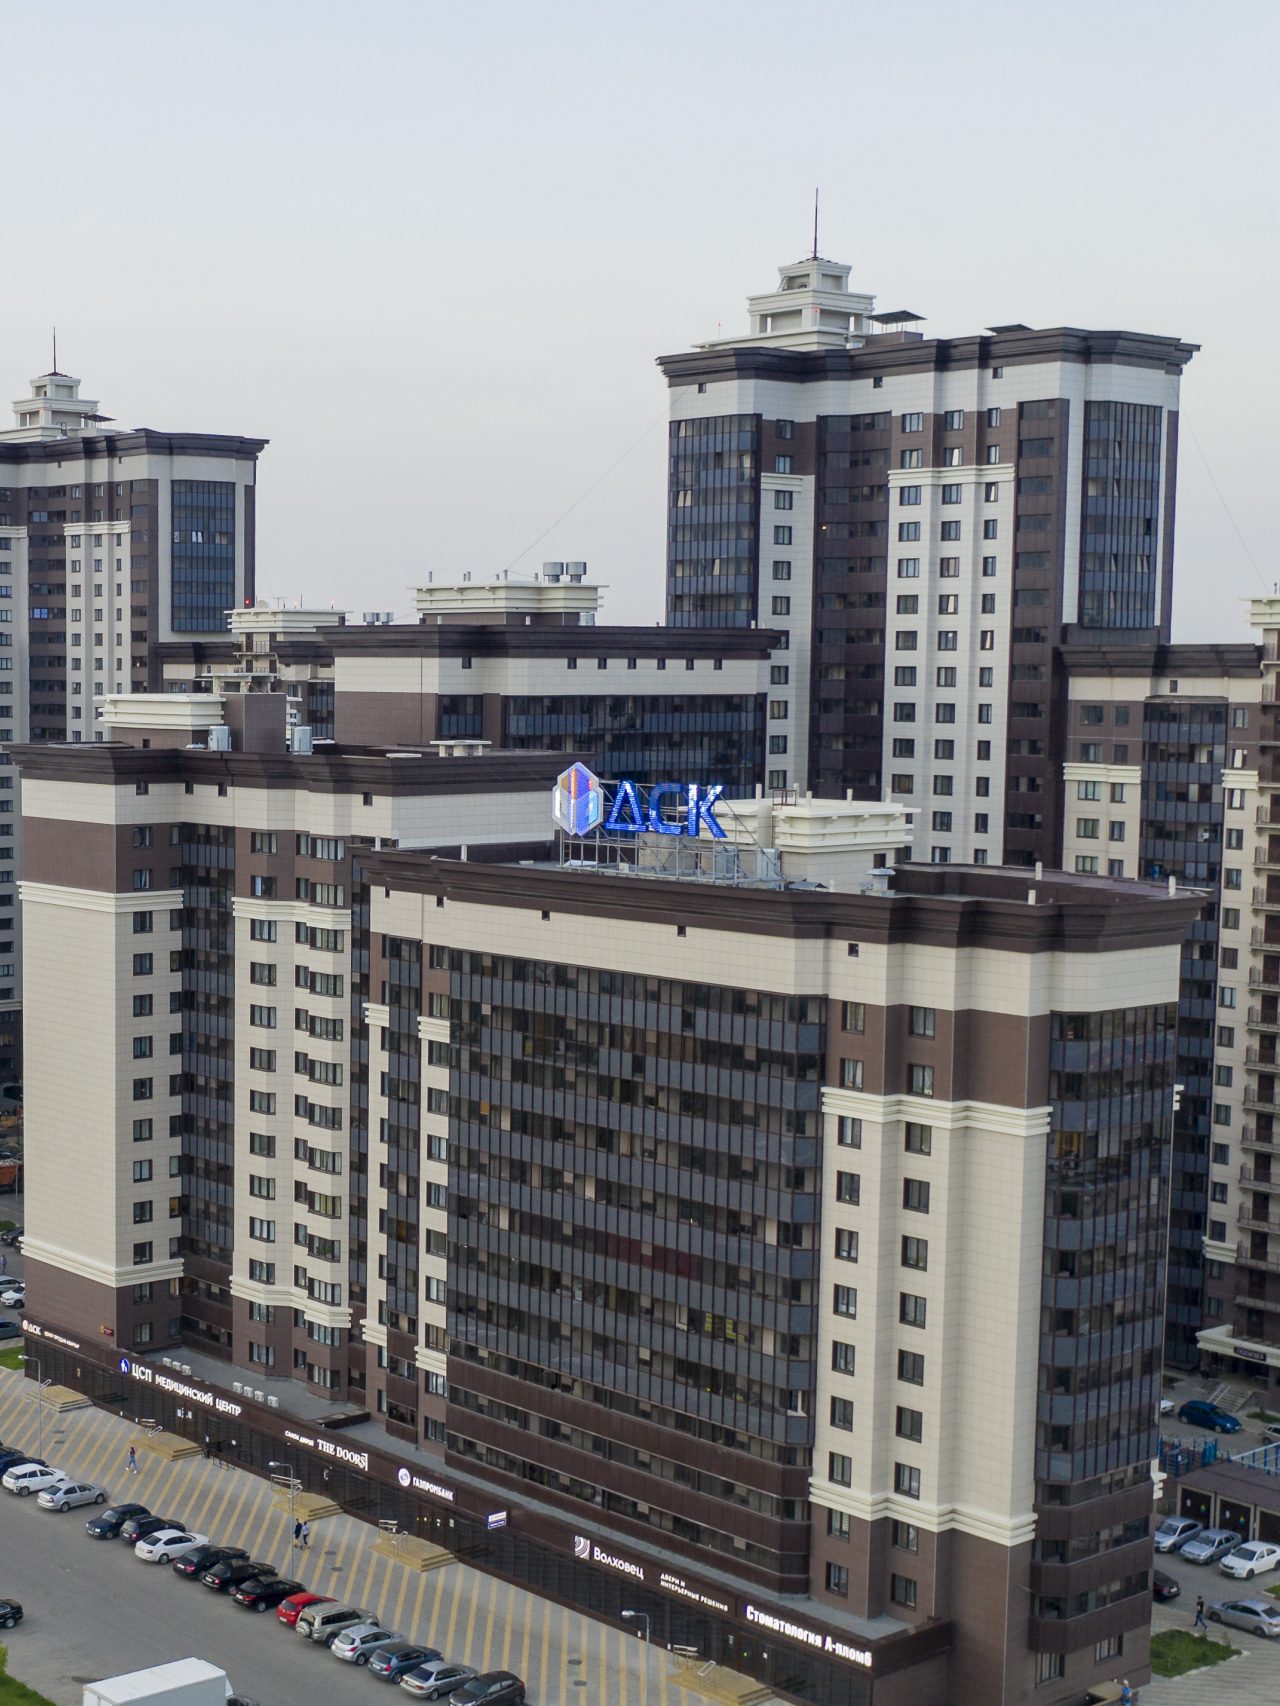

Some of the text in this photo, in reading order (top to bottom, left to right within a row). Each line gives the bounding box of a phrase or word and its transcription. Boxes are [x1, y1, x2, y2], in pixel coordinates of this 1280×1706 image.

[131, 1363, 241, 1416] ЦСП МЕДИЦИНСКИЙ ЦЕНТР
[317, 1439, 365, 1469] THE DOORS
[413, 1477, 454, 1501] ГАЗПРОМБАНК
[593, 1546, 644, 1580] Волховец
[660, 1573, 681, 1586] ДВЕРИ
[660, 1580, 729, 1612] ИНТЕРЬЕРНЫЕ РЕШЕНИЯ
[746, 1605, 873, 1667] Стоматология А-пломб
